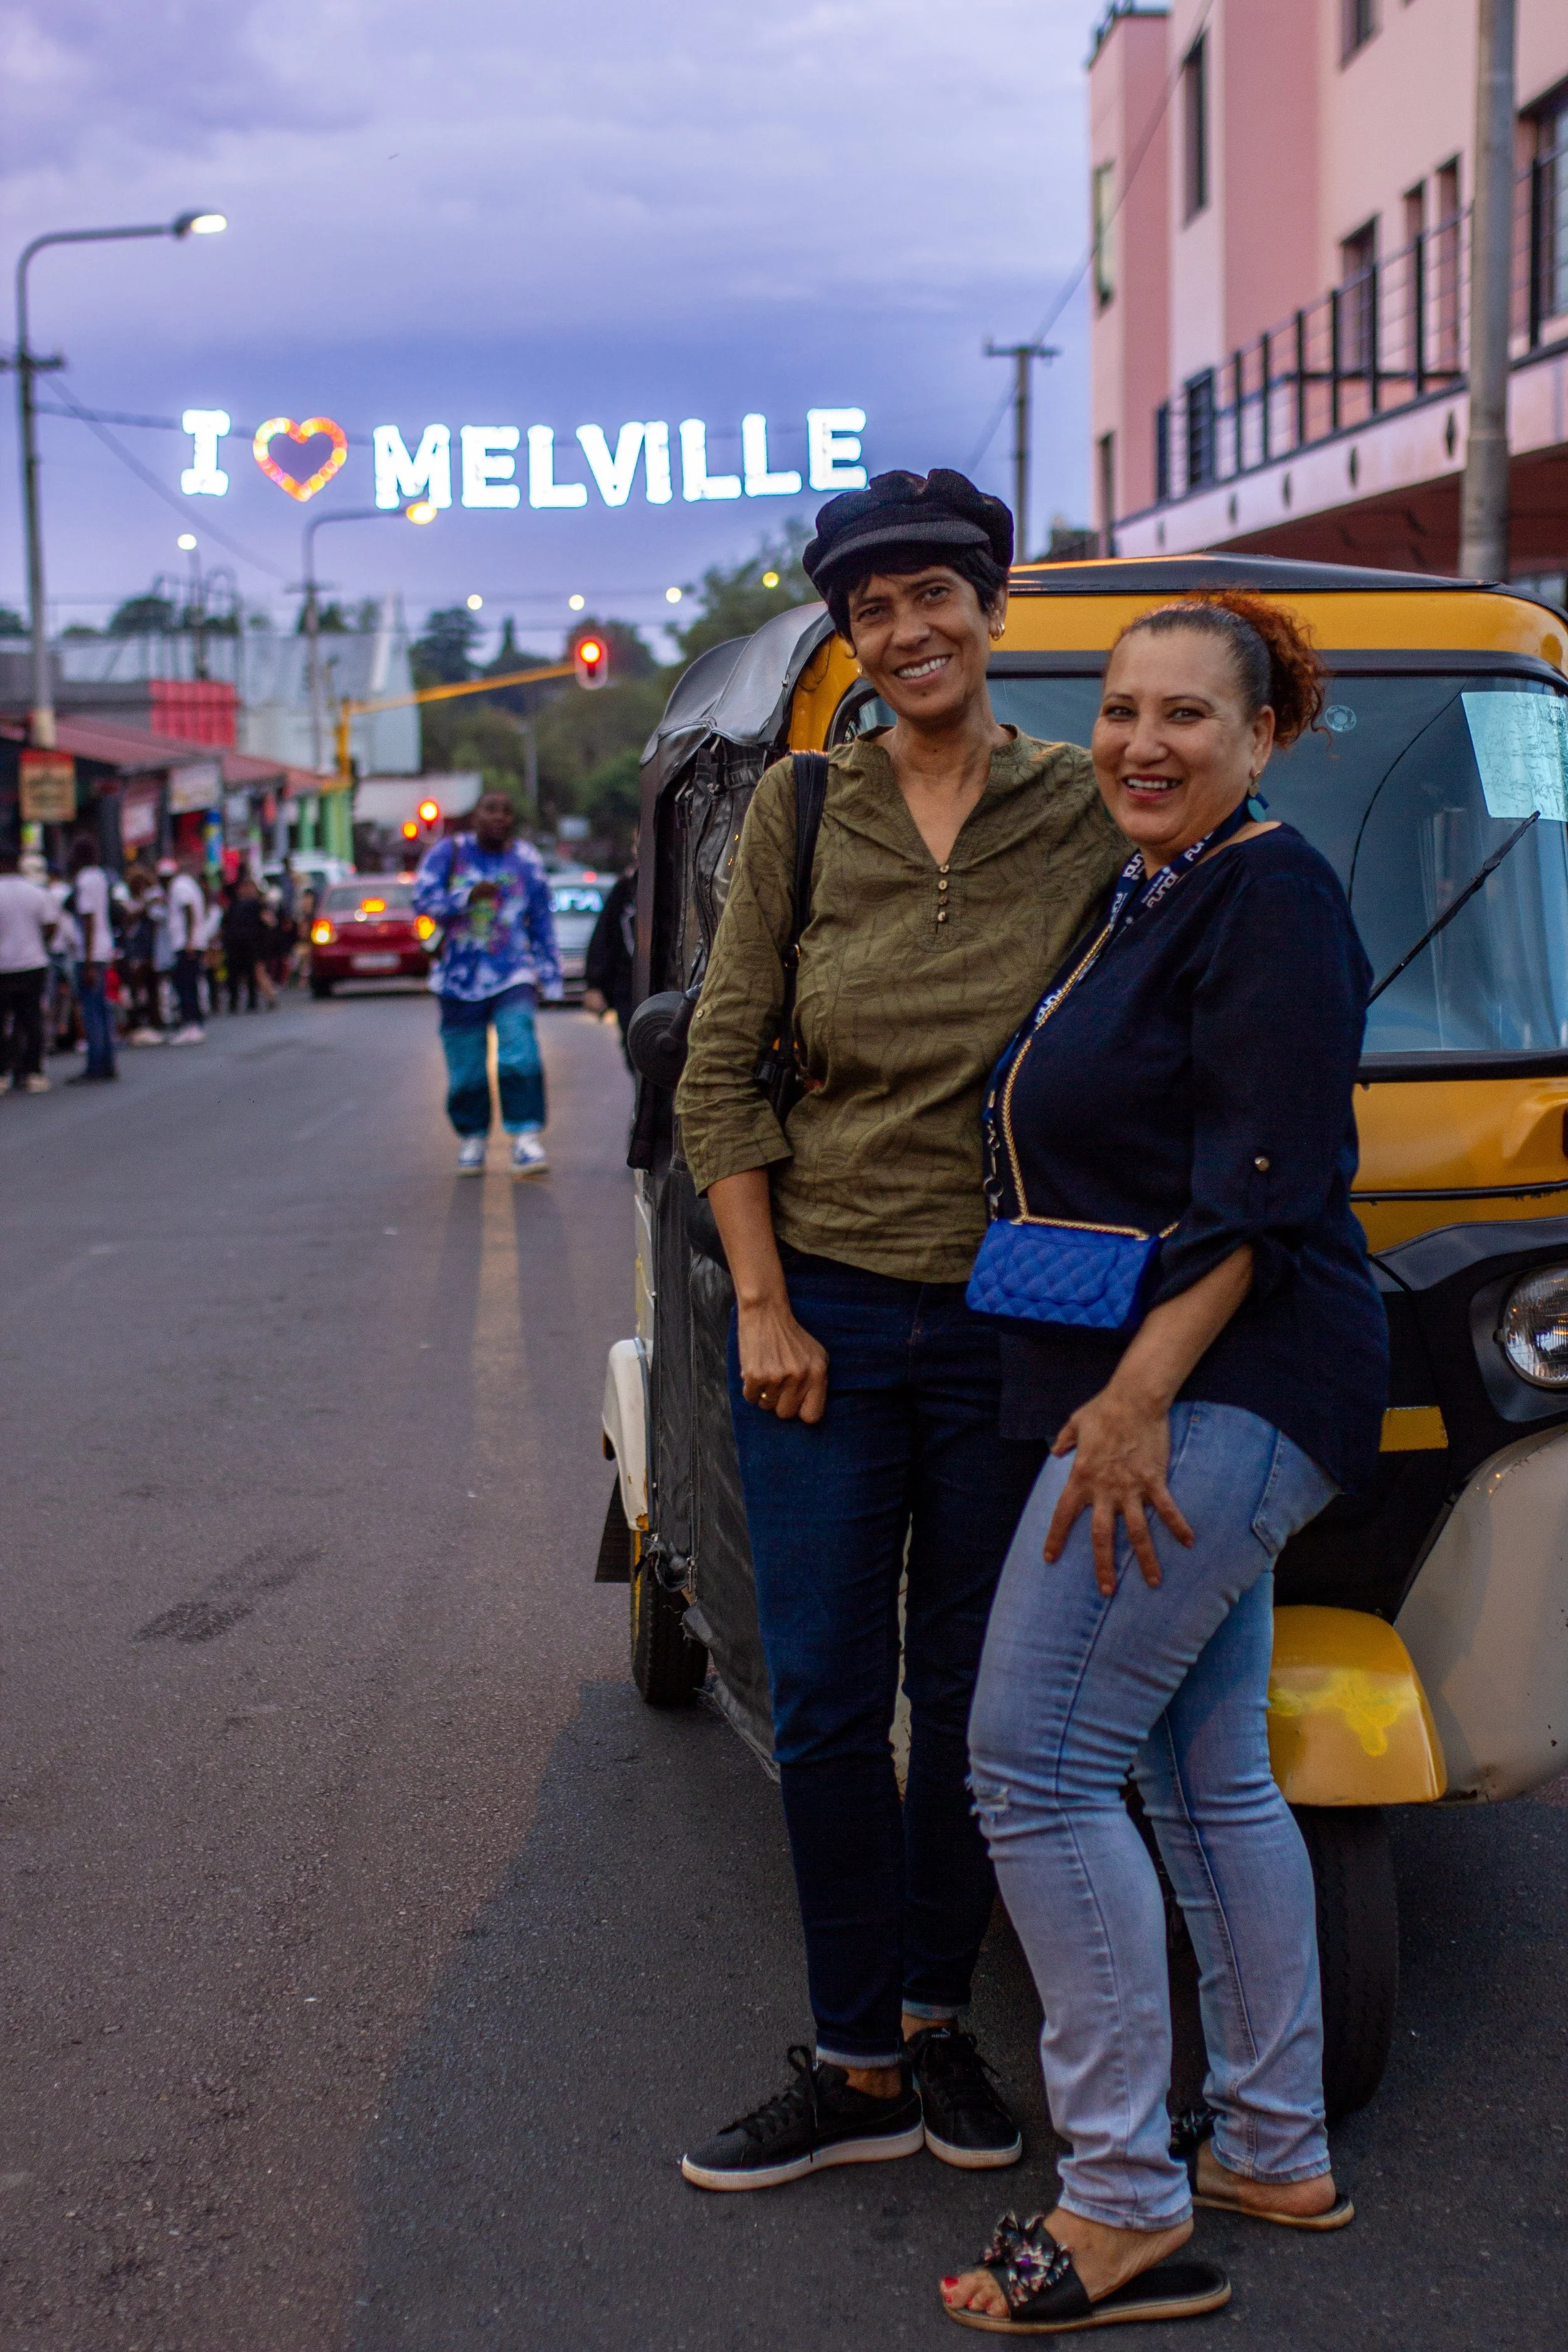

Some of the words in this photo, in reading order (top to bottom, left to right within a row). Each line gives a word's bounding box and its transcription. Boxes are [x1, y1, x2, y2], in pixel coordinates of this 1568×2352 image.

[181, 409, 231, 496] I
[373, 408, 866, 508] MELVILLE
[1122, 853, 1144, 878] UNDI
[1146, 871, 1179, 908] FUNDI
